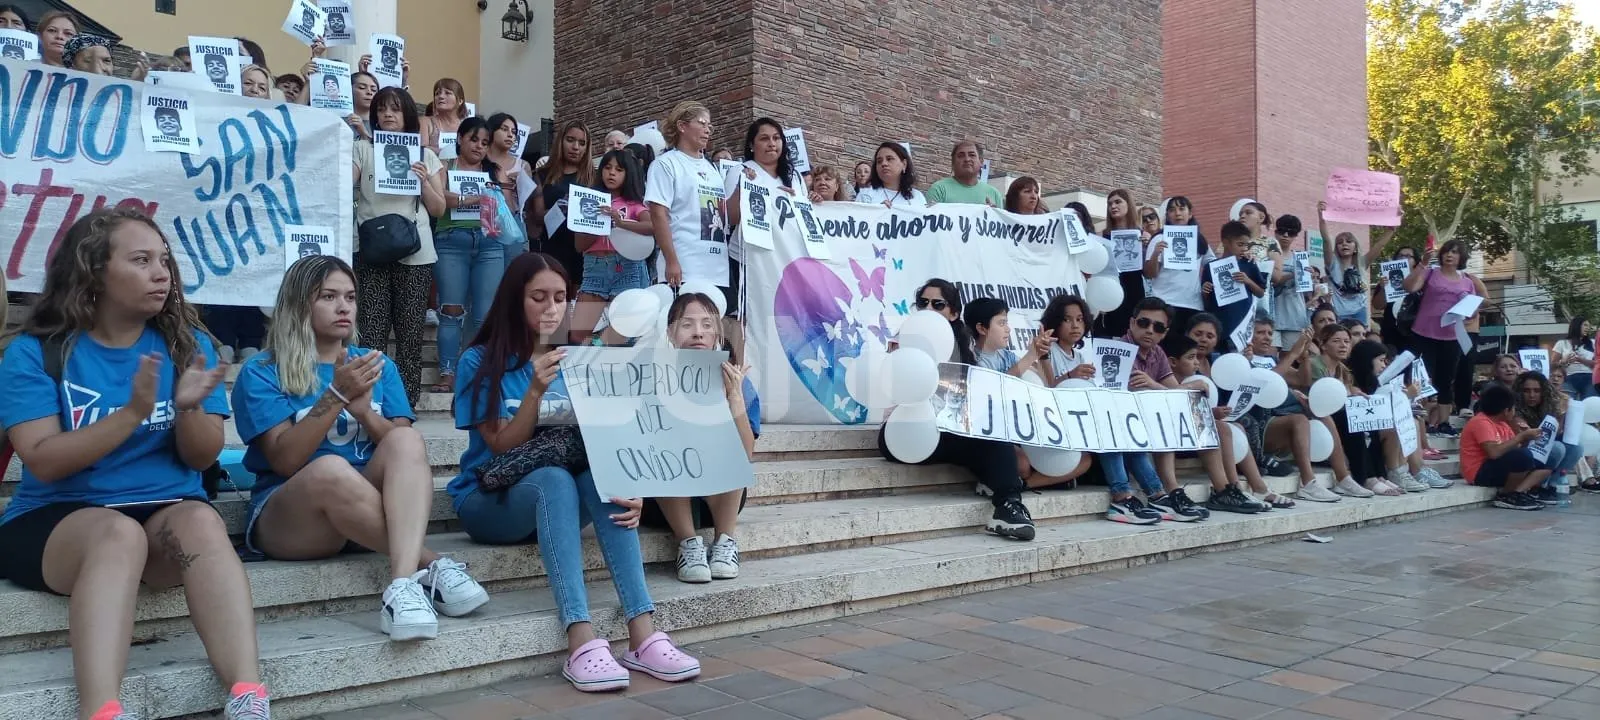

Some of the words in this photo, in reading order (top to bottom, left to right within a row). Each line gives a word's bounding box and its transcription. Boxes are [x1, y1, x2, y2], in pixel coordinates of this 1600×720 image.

[0, 36, 33, 50] USTICIA
[195, 44, 234, 57] JUSTICIA
[147, 95, 189, 111] JUSTICIA
[375, 133, 419, 147] JUSTICIA
[180, 103, 298, 202] SAN
[453, 175, 486, 183] JUSTICIA
[744, 181, 770, 197] JUSTICIA
[573, 190, 607, 203] JUSTICIA
[173, 172, 304, 296] JUAN
[876, 214, 953, 241] ahora
[959, 217, 972, 243] y
[976, 210, 1060, 247] siempre!!
[1167, 231, 1193, 239] JUSTICIA
[291, 233, 329, 243] JUSTICIA
[1382, 261, 1408, 272] JUSTICIA
[1097, 346, 1131, 358] JUSTICIA
[627, 362, 712, 397] PERDÓN
[1237, 384, 1261, 394] JUSTICIA
[635, 400, 672, 435] NI
[981, 393, 1196, 448] JUSTICIA
[149, 423, 166, 431] DEL
